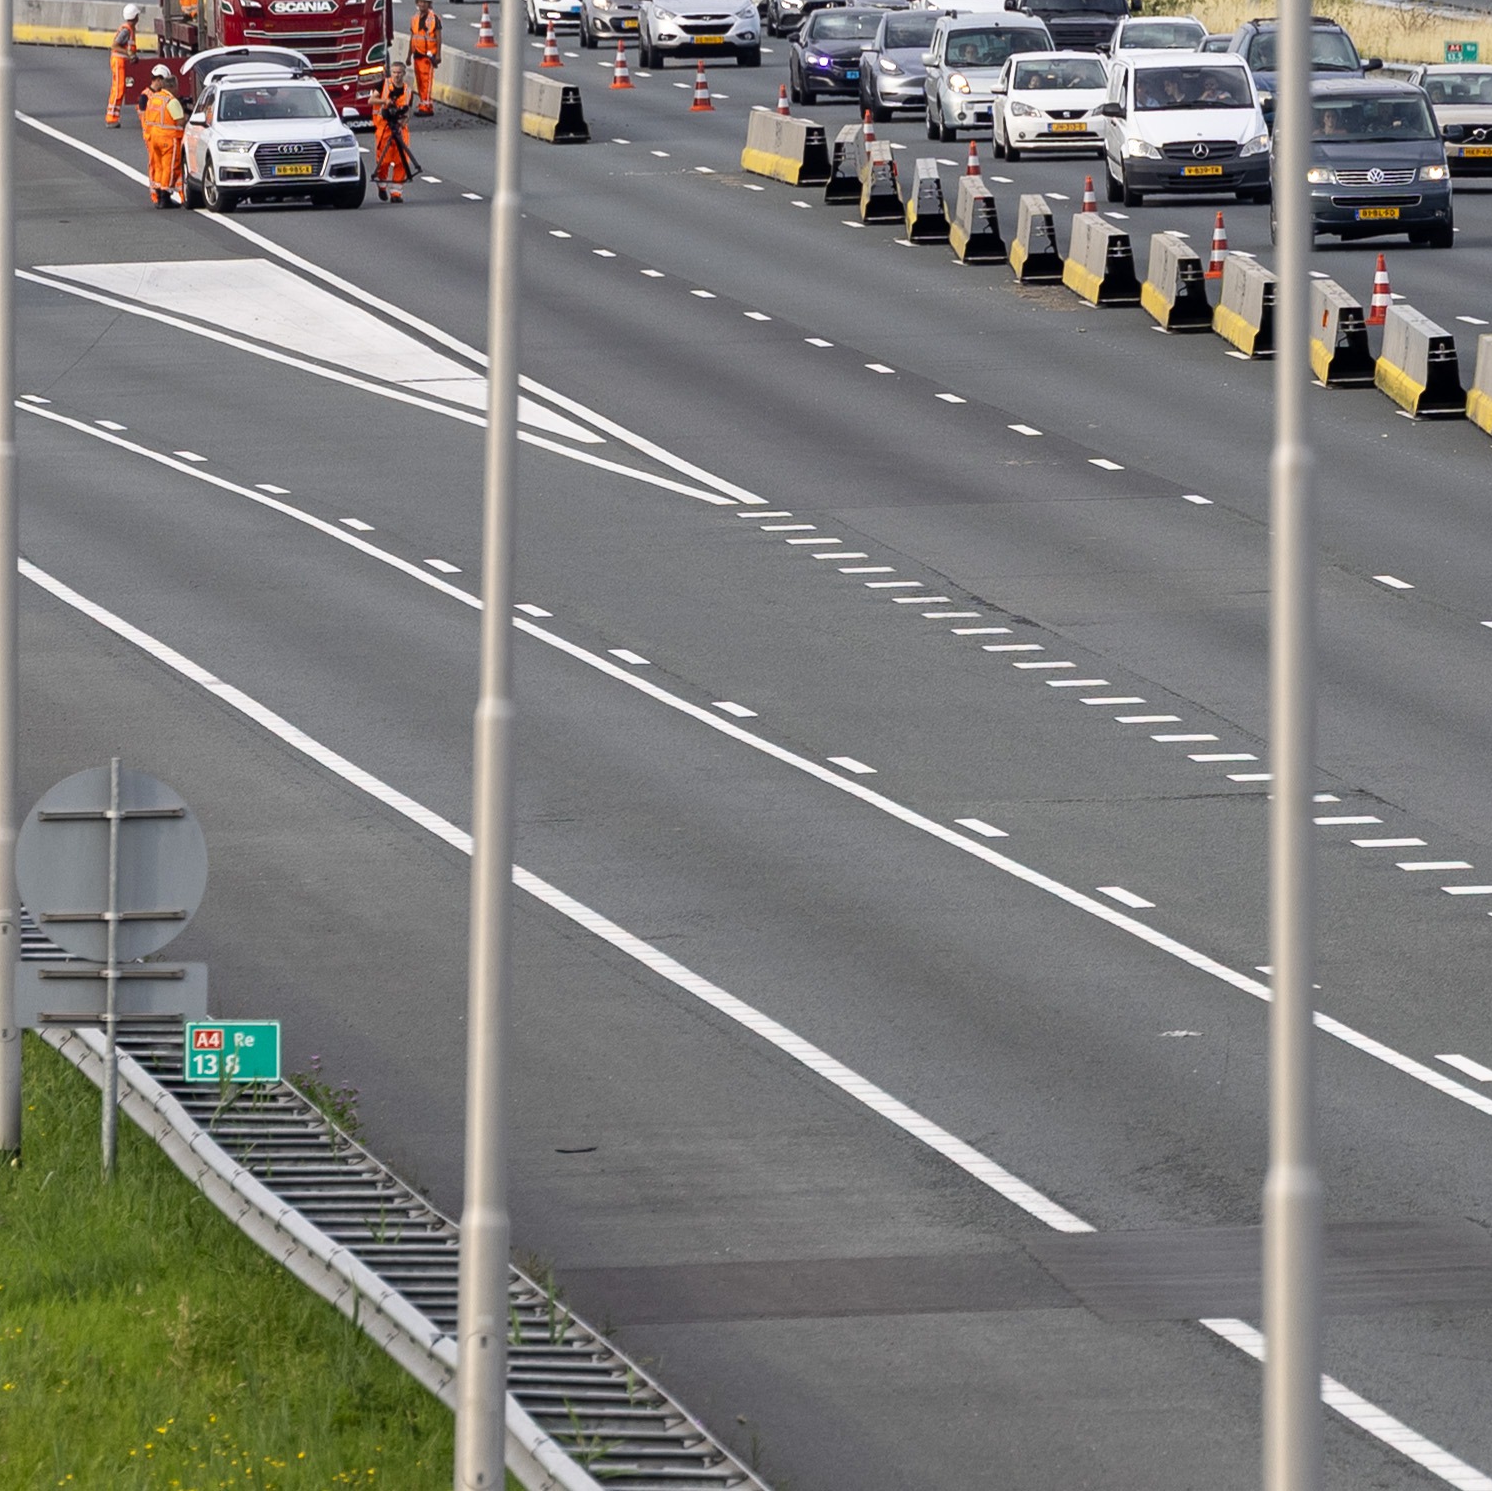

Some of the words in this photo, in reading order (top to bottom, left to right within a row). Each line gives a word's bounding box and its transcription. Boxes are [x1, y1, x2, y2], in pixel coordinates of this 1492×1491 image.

[274, 1, 332, 13] SCANIA
[195, 1032, 220, 1048] A4
[233, 1031, 255, 1048] Re
